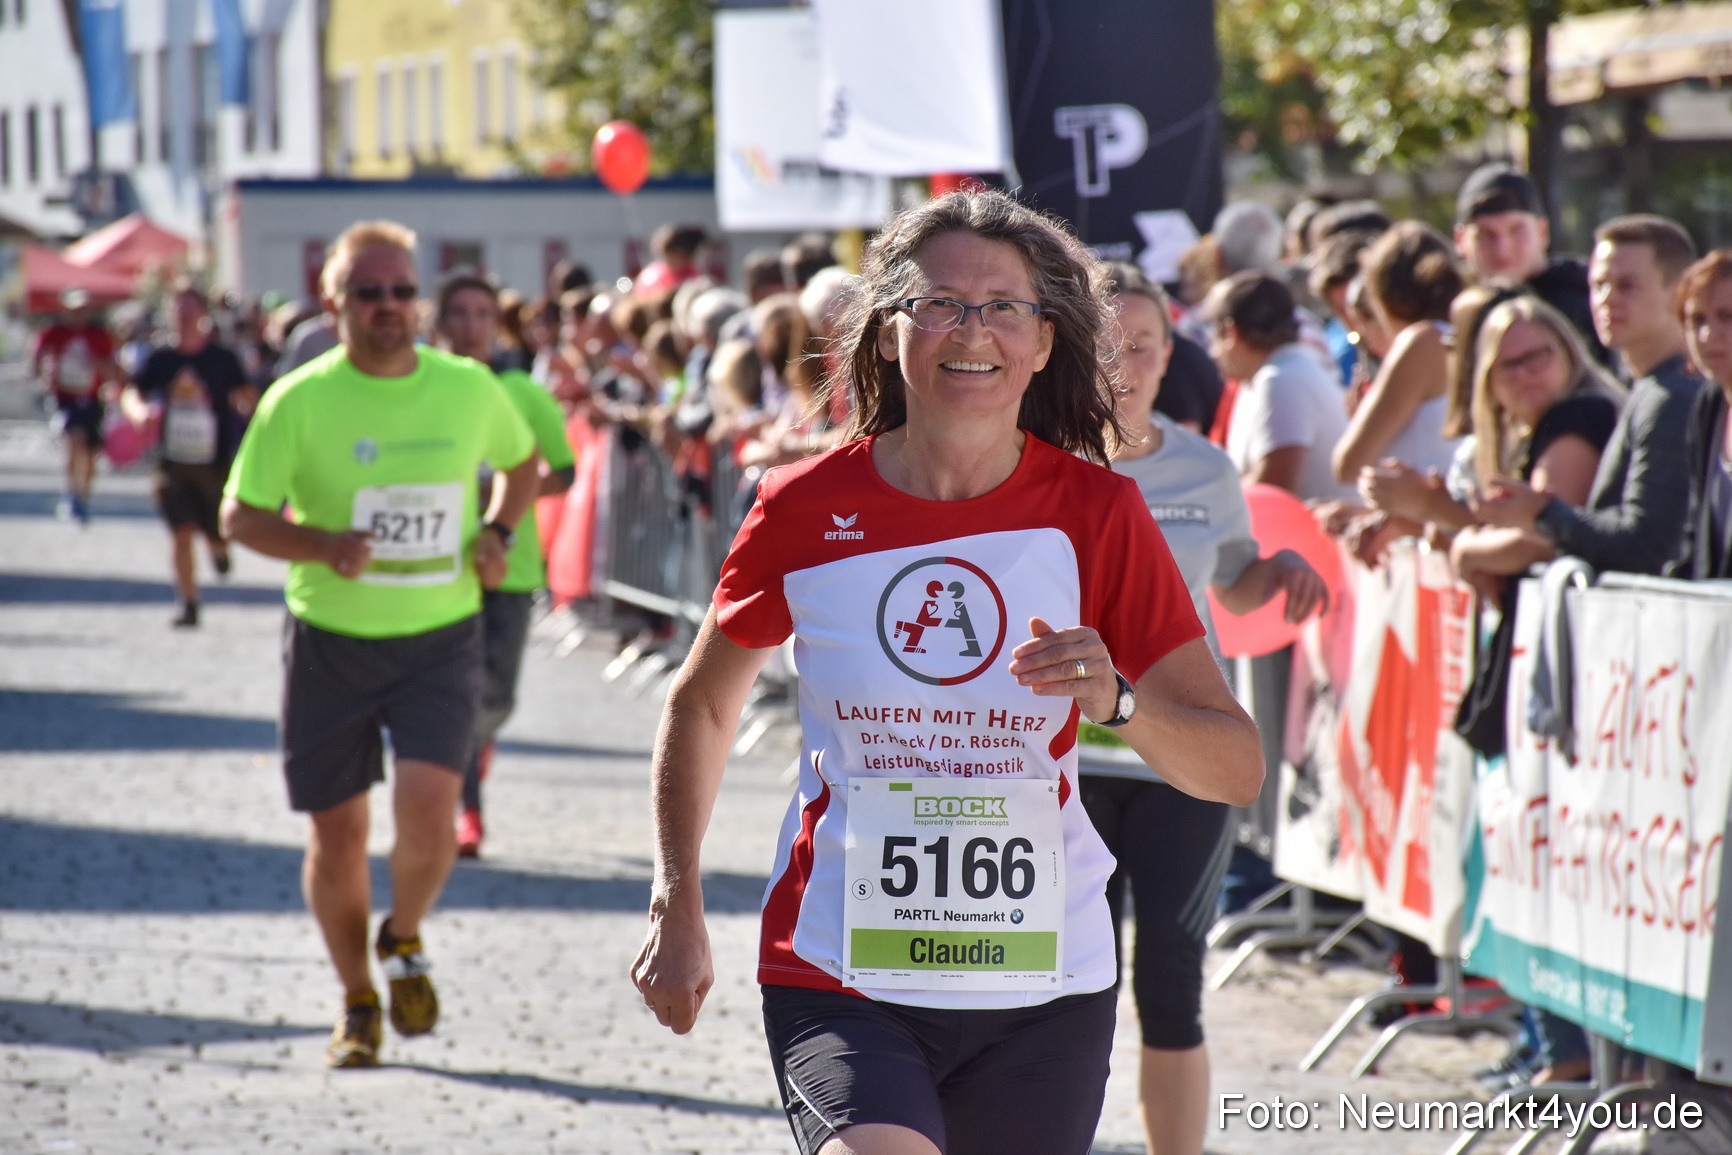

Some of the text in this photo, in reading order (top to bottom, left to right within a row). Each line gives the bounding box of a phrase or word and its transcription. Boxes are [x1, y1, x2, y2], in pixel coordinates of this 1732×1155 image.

[370, 509, 447, 544] 5217
[824, 529, 865, 541] erima
[861, 732, 885, 745] Dr.
[887, 732, 926, 749] Heck
[941, 735, 966, 750] Dr.
[864, 754, 1025, 779] Leistungsdiagnostik
[914, 796, 1009, 818] BOCK
[913, 818, 943, 827] inspired
[945, 819, 954, 827] by
[978, 819, 1010, 828] concepts
[880, 835, 1036, 900] 5166
[858, 884, 867, 896] S
[894, 909, 940, 921] PARTL
[943, 910, 1006, 922] Neumarkt
[909, 937, 1005, 965] Claudia
